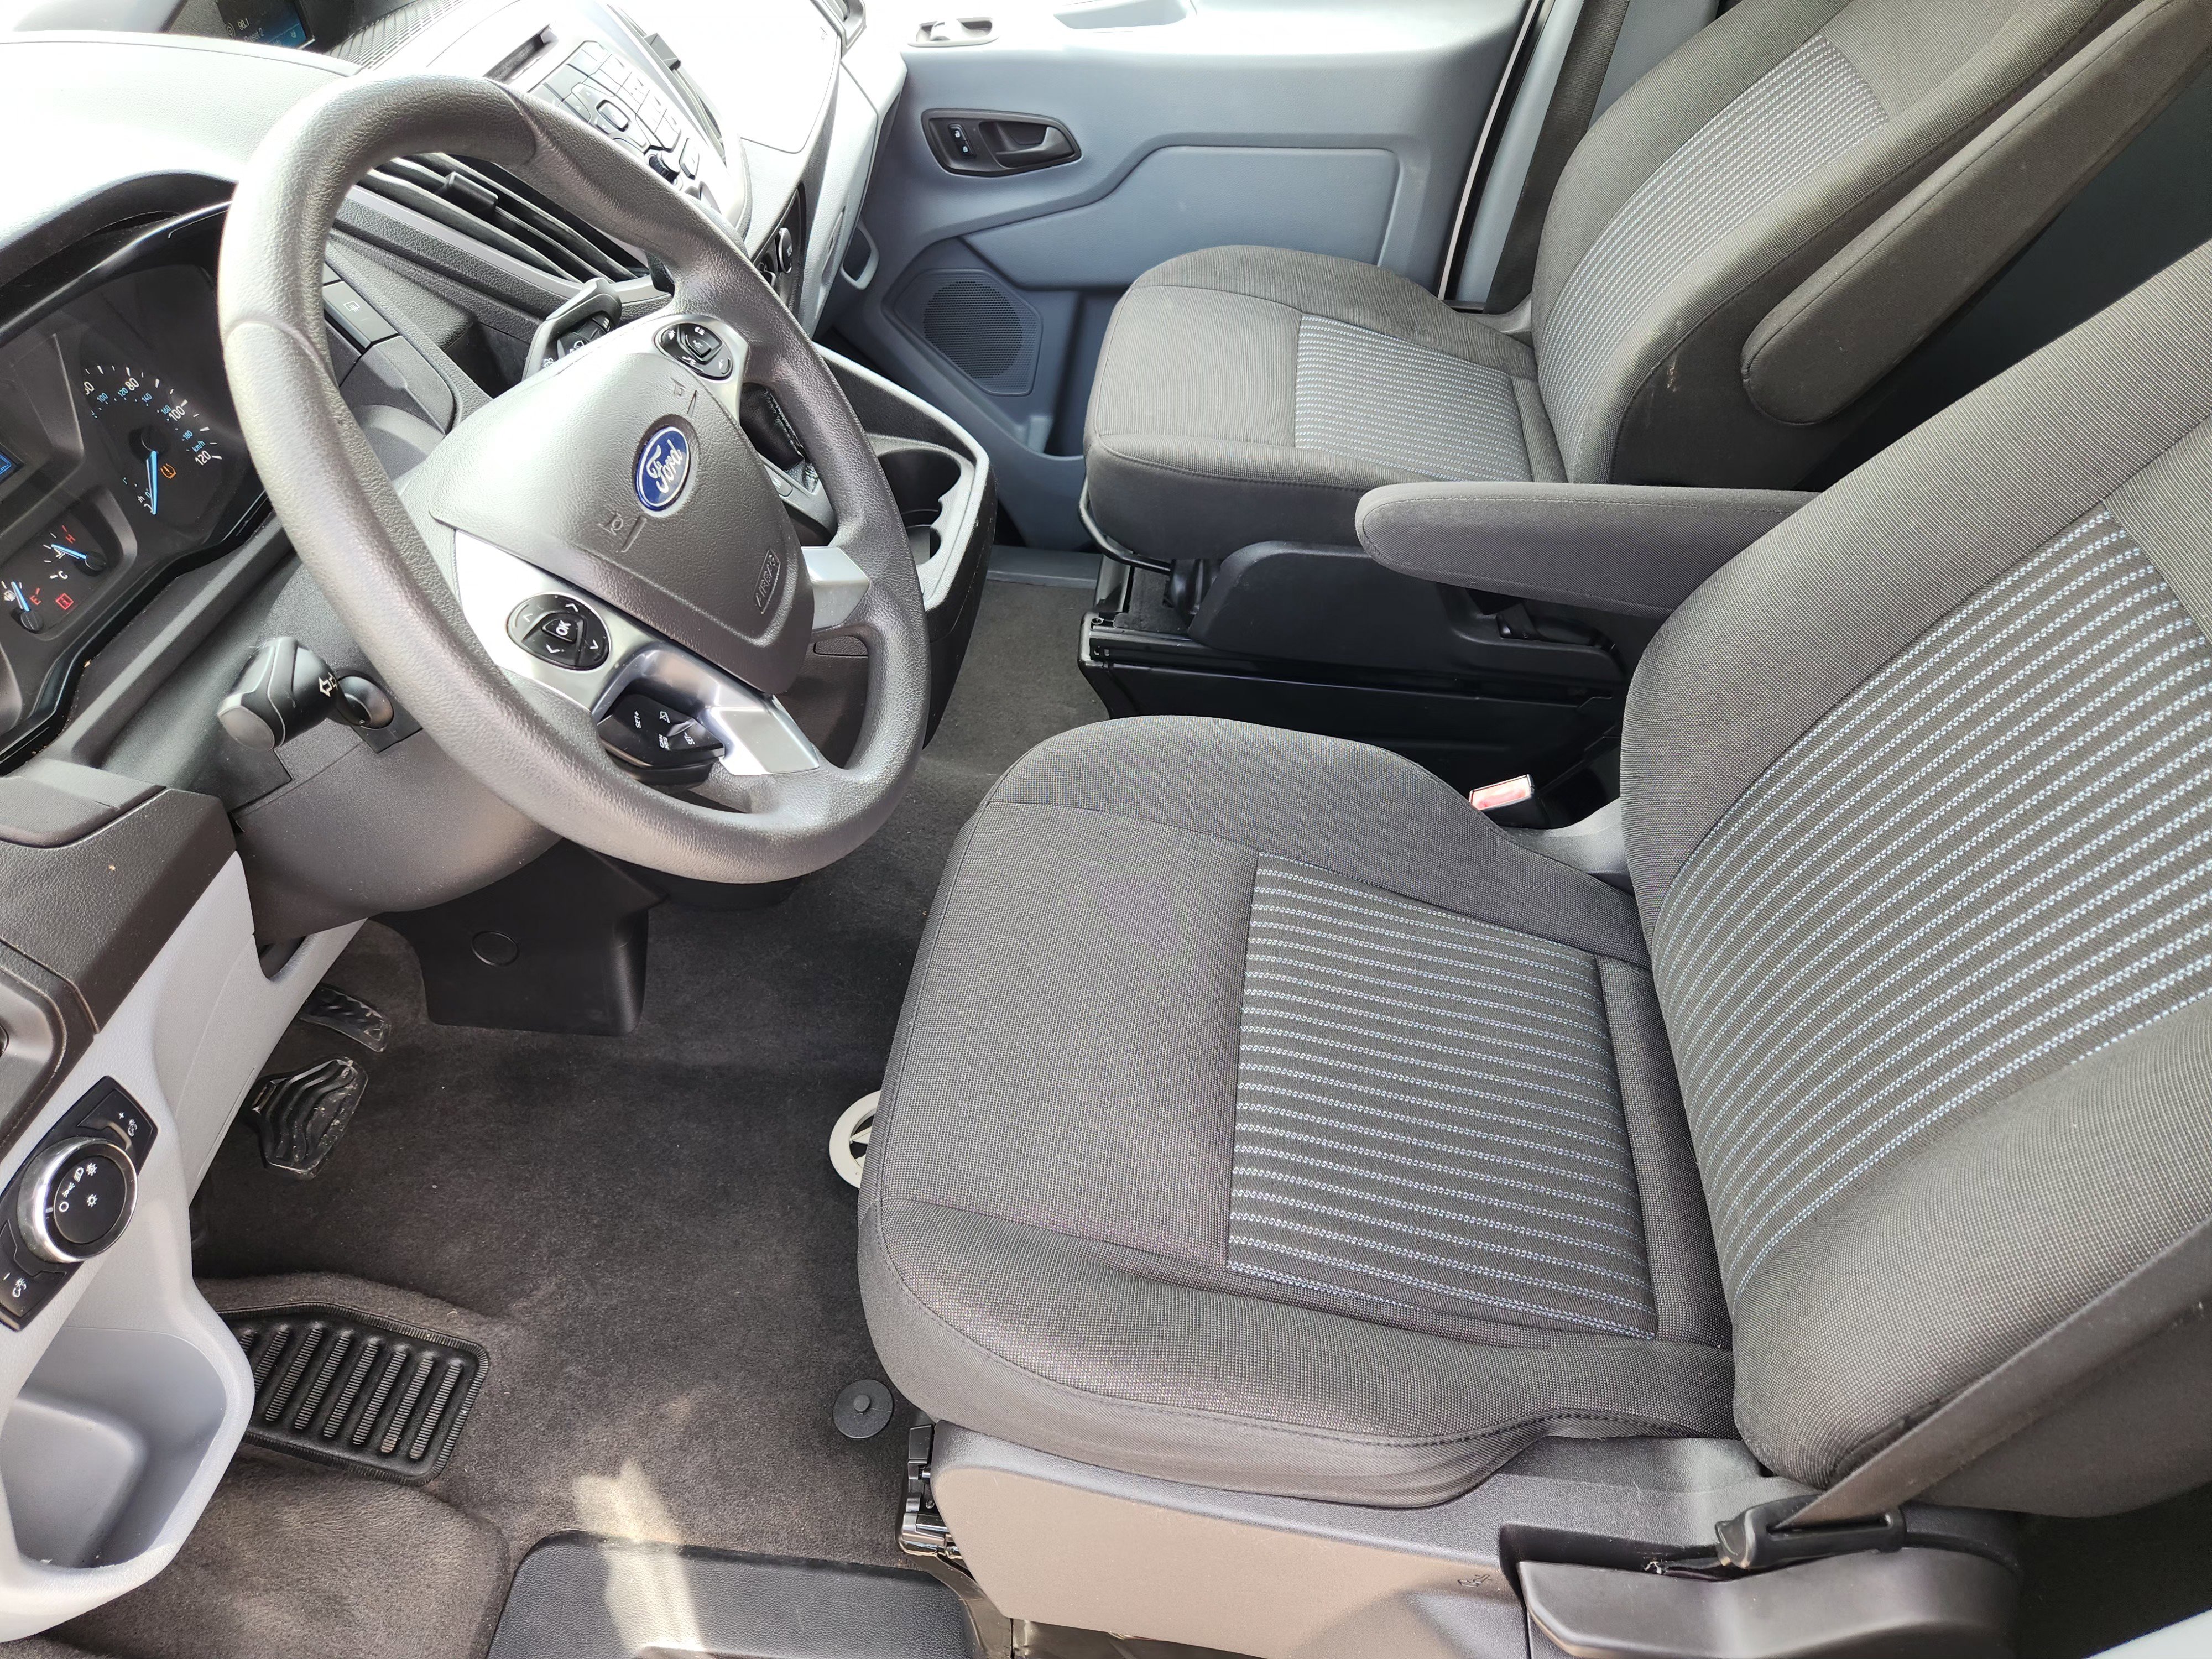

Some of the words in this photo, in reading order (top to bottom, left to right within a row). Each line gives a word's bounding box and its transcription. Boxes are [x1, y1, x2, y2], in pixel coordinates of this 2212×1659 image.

[238, 18, 251, 30] 98.1
[258, 28, 264, 36] 2
[125, 378, 139, 391] 80
[117, 387, 128, 397] 120
[97, 393, 108, 403] 100
[142, 393, 153, 403] 140
[161, 405, 171, 415] 160
[169, 405, 185, 421] 100
[183, 430, 193, 440] 180
[191, 440, 205, 453] km/h
[195, 450, 211, 466] 120
[646, 439, 682, 493] Ford
[65, 534, 76, 544] H
[58, 571, 68, 580] C
[754, 555, 776, 607] AIRBAG
[30, 595, 41, 606] E
[556, 619, 571, 636] OK
[684, 732, 695, 745] SET-
